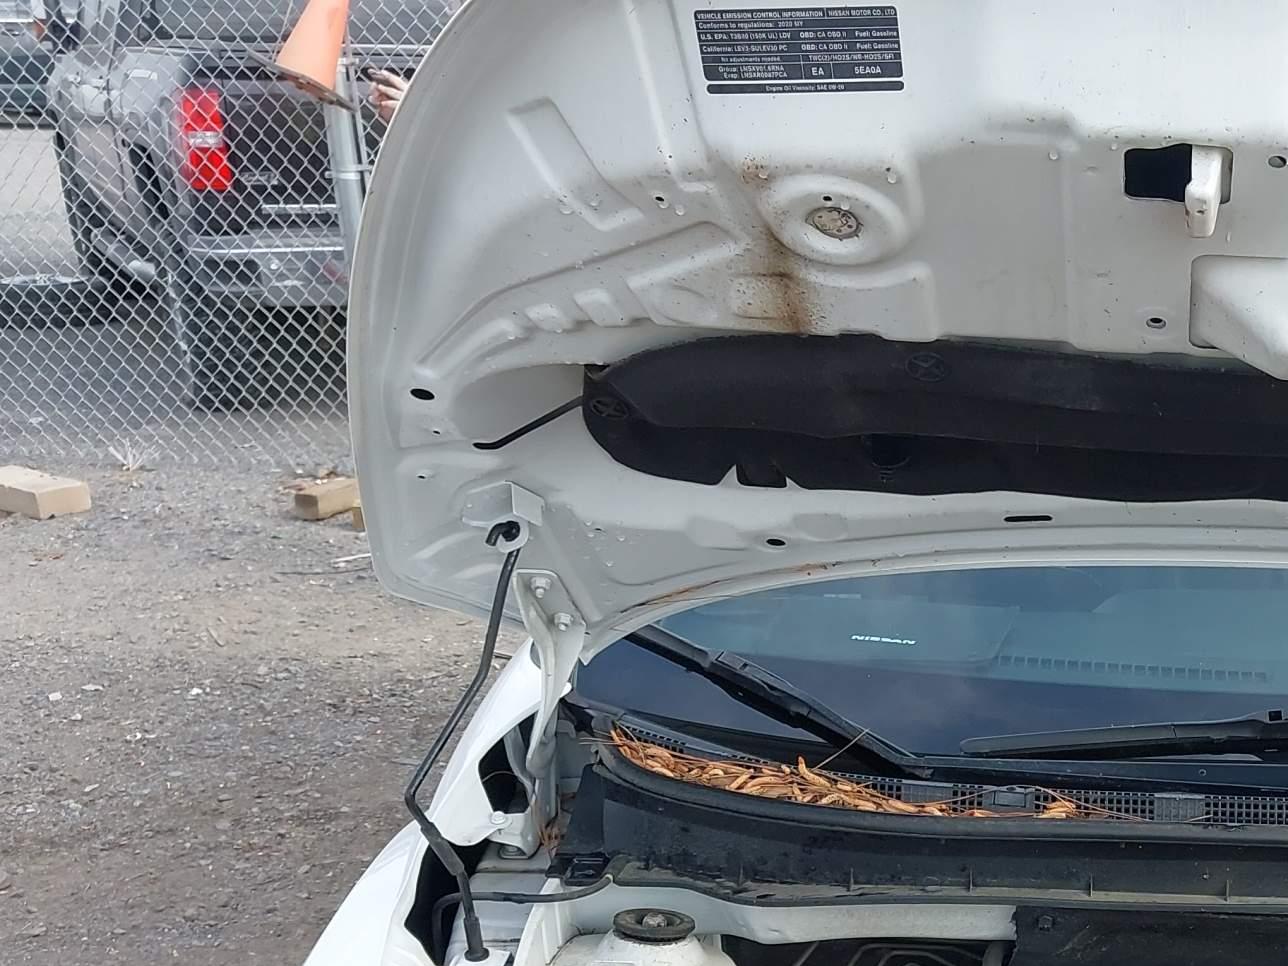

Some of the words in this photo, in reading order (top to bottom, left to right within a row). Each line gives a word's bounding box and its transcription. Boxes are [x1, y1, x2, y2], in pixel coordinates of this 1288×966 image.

[696, 12, 721, 20] VEHICLE
[753, 11, 780, 19] CONTROL
[782, 10, 823, 18] INFORMATION
[828, 9, 850, 17] NISSAN
[811, 67, 825, 76] EA
